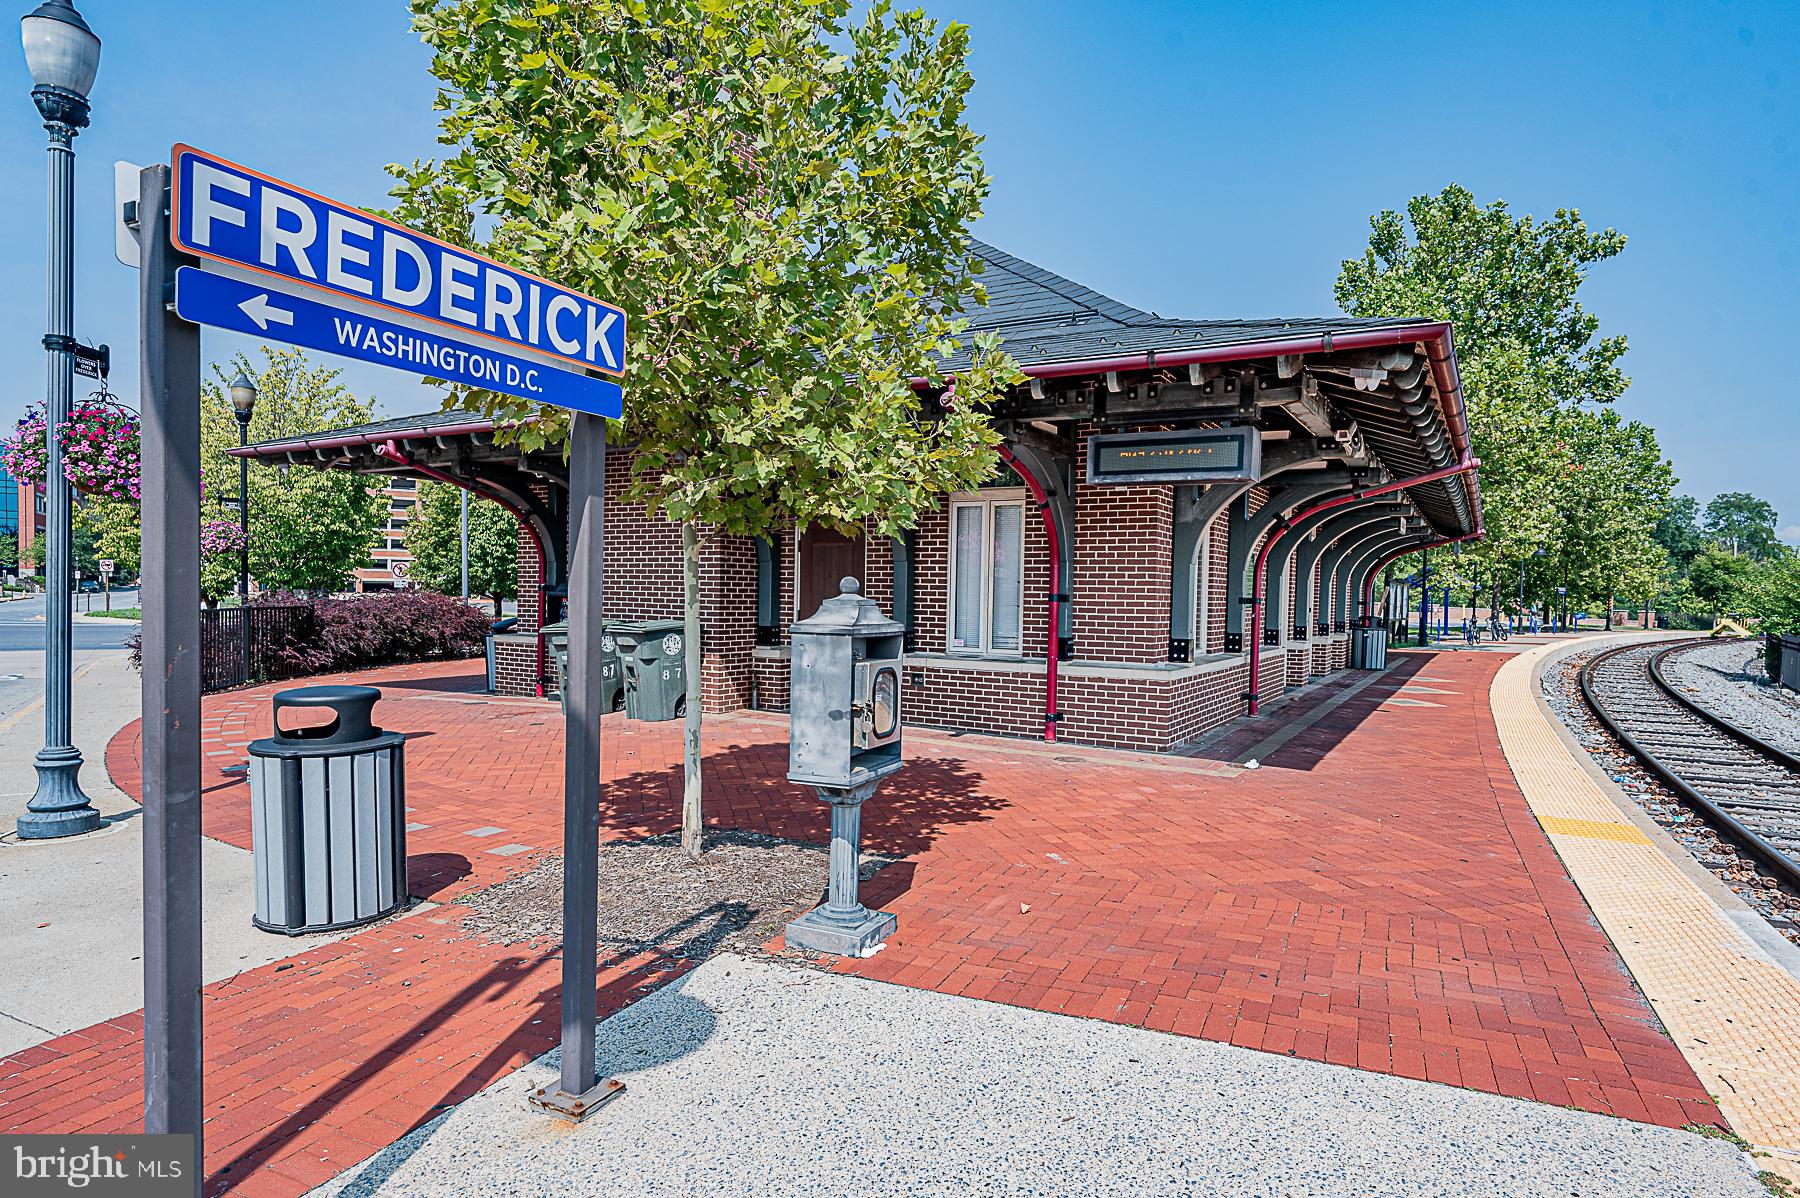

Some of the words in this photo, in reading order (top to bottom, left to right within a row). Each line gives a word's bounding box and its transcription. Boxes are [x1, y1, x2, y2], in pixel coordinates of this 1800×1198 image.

[191, 161, 617, 368] FREDERICK
[75, 367, 98, 378] FREDERICK
[76, 357, 97, 368] FLOWERS
[333, 317, 499, 383] WASHINGTON
[506, 363, 543, 393] D.C.
